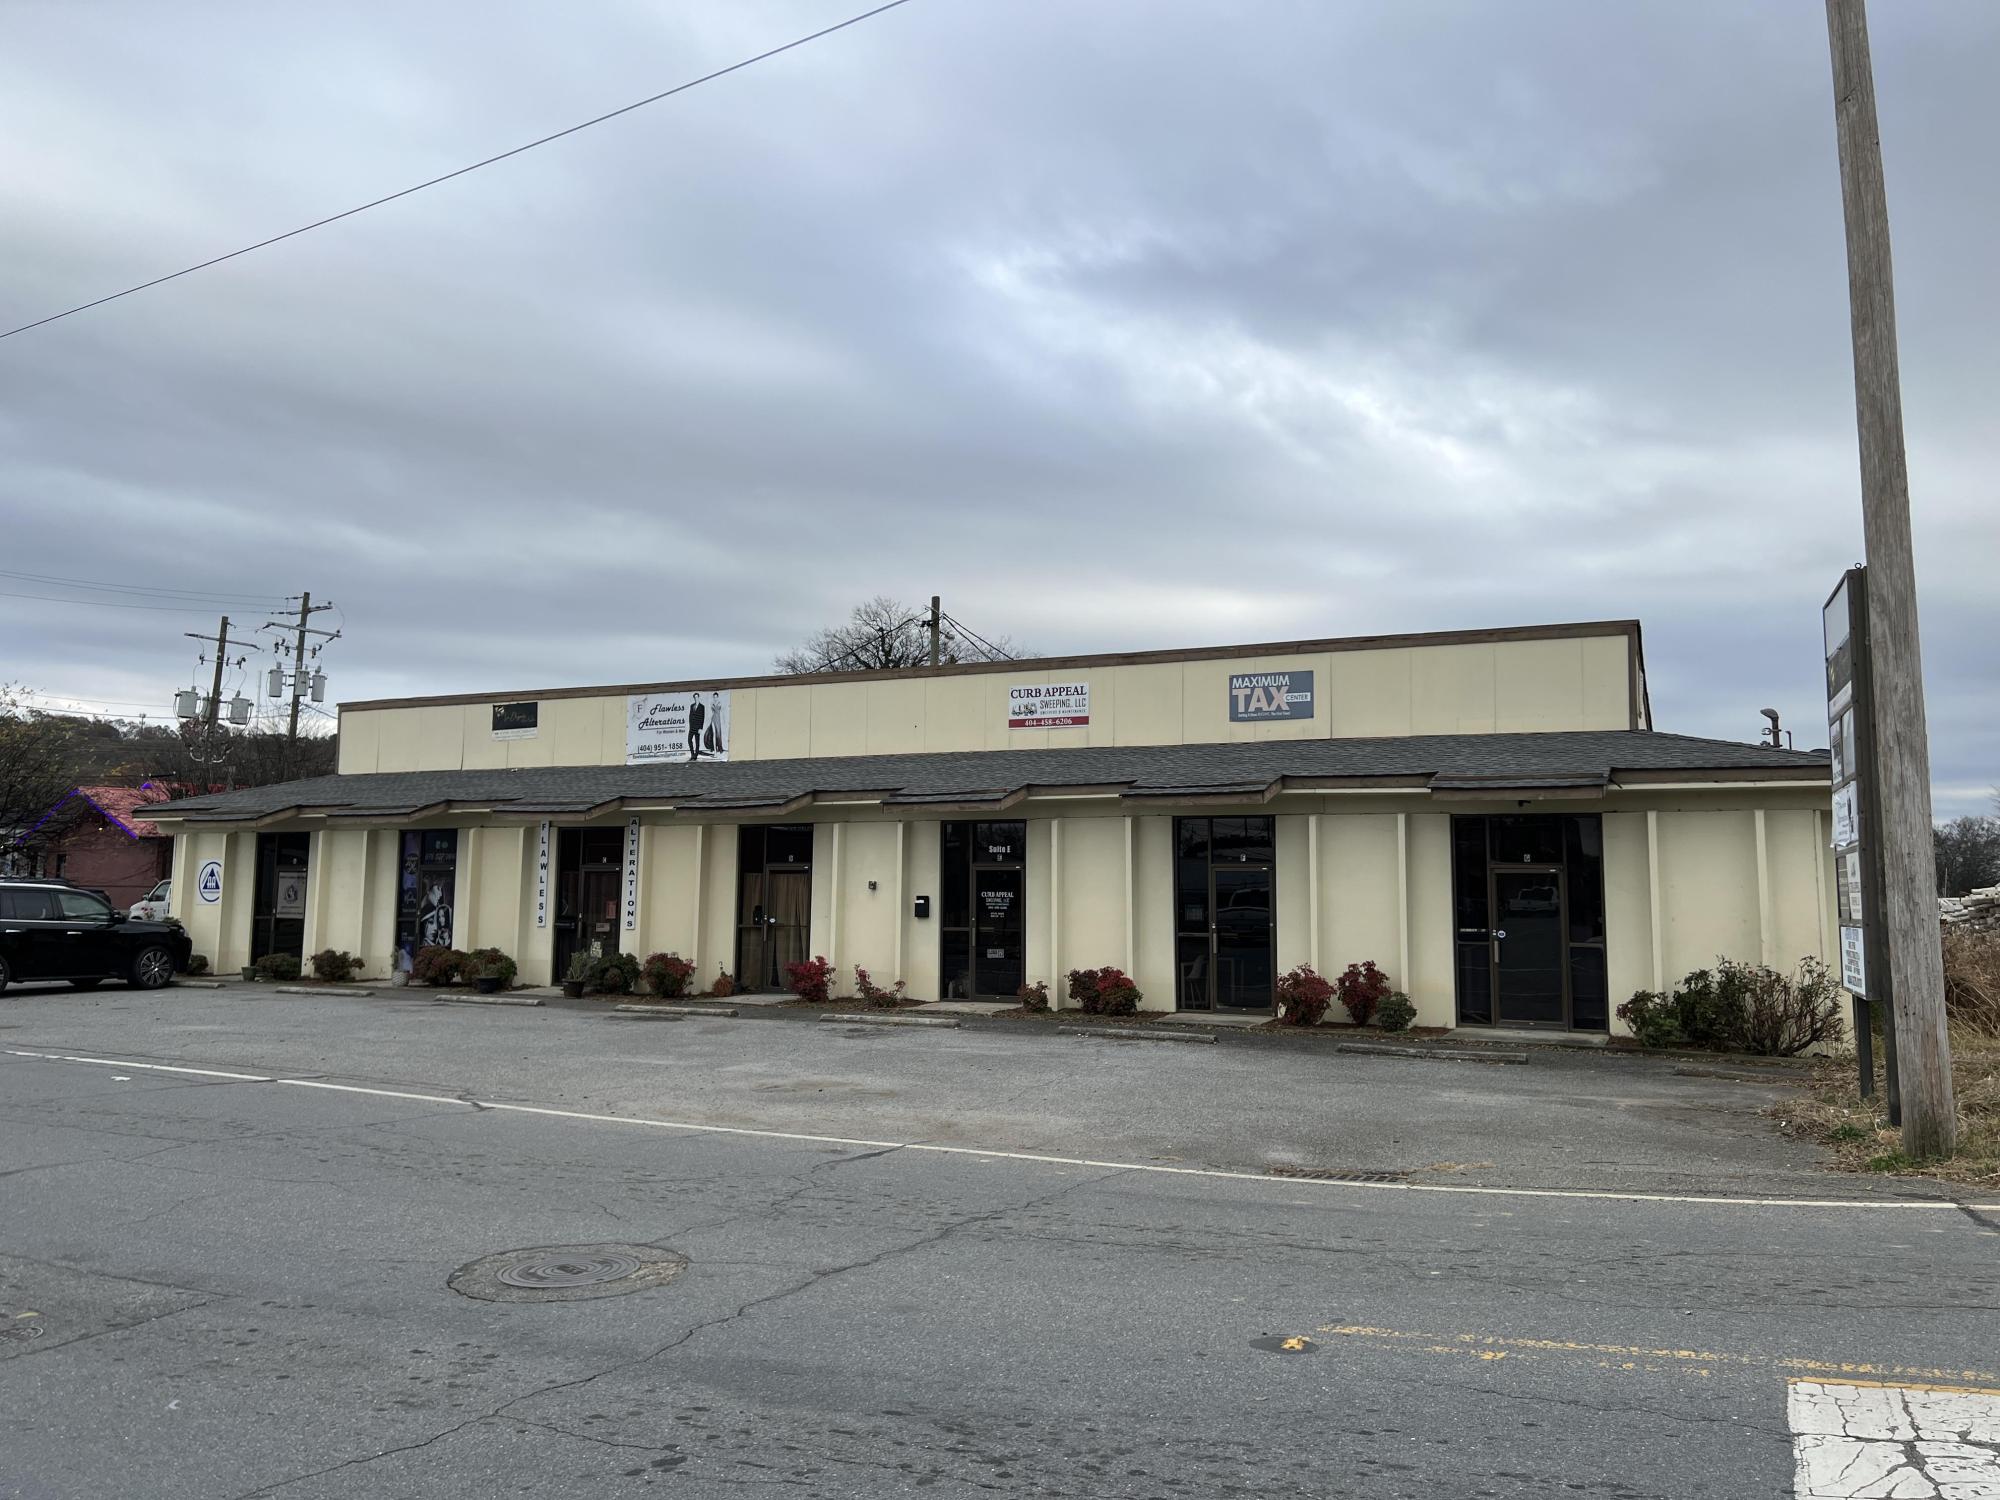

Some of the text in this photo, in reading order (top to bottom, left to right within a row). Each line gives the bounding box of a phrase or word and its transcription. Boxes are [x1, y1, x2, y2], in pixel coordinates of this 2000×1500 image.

[1232, 675, 1290, 688] MAXIMUM
[1010, 686, 1087, 699] CURB APPEAL
[1232, 686, 1290, 712] TAX
[650, 703, 685, 715] Flawless
[1075, 698, 1086, 707] LLC
[638, 717, 685, 729] Alterations
[538, 823, 548, 924] FLAWLESS
[627, 819, 638, 928] ALTERATIONS
[207, 876, 216, 888] AA
